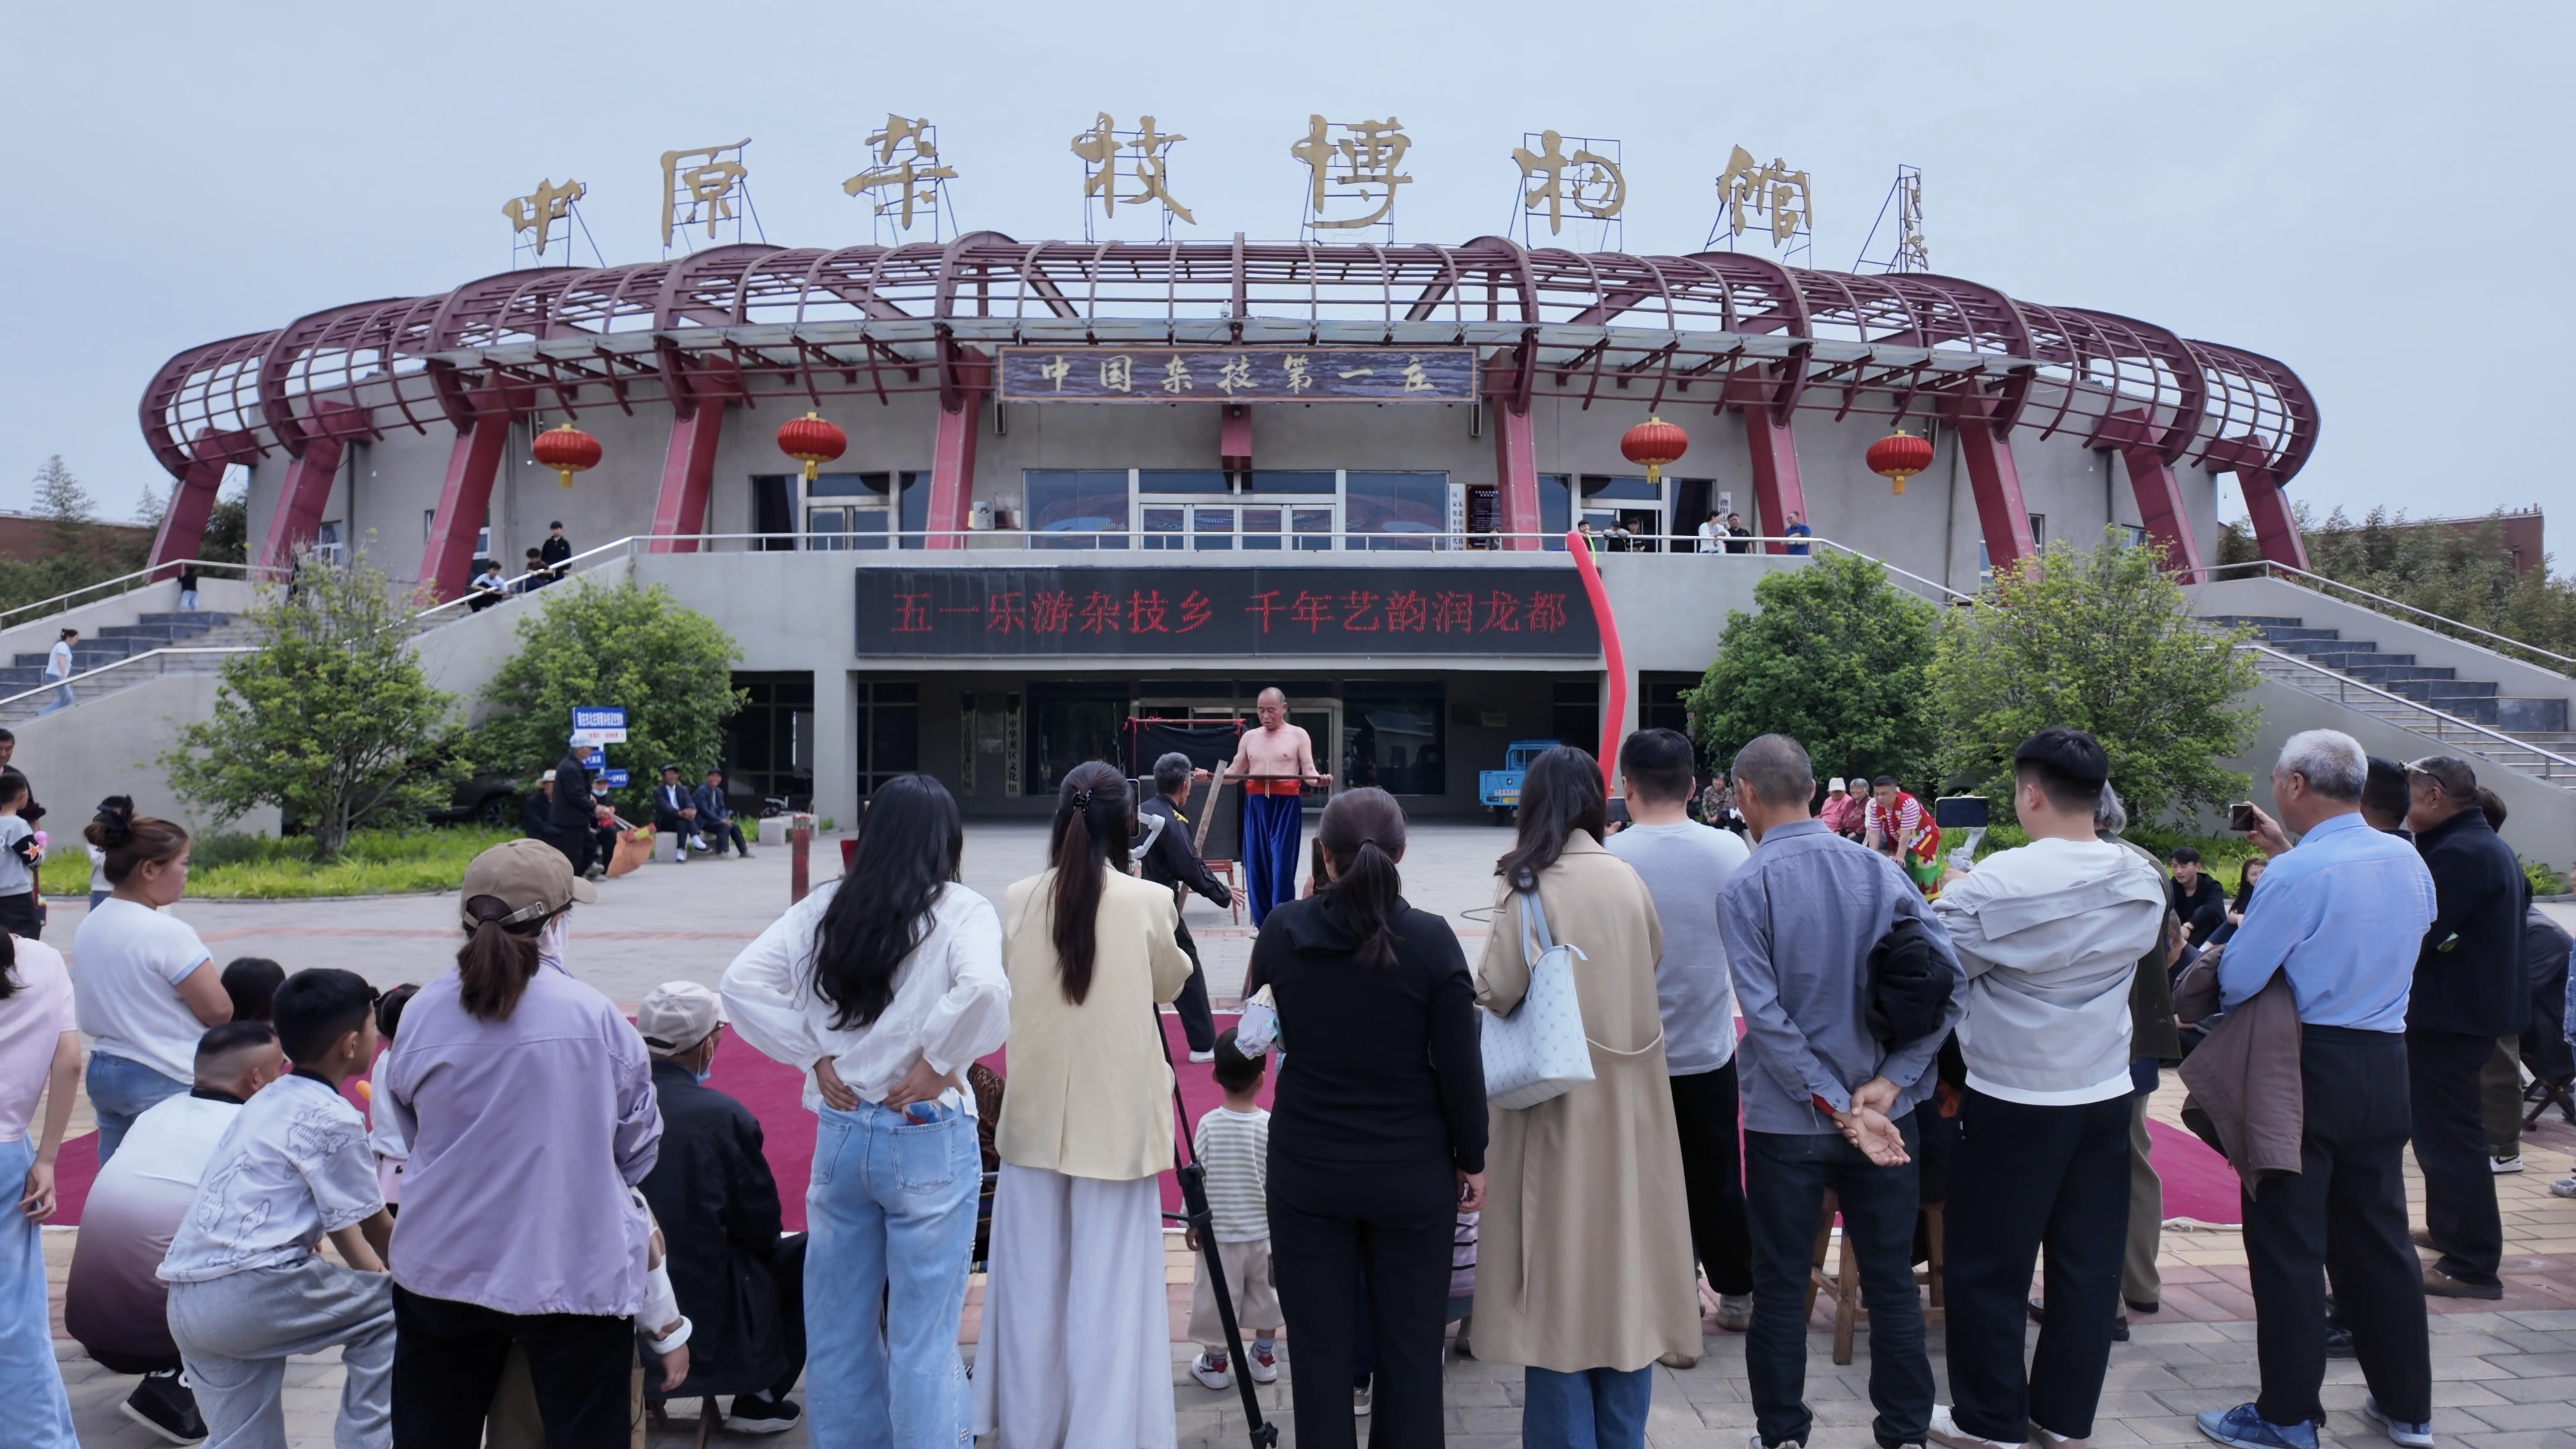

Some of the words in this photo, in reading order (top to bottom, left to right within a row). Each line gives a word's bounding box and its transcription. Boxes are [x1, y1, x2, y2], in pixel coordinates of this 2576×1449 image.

[1042, 353, 1435, 394] 中国杂技第一庄
[891, 590, 1212, 634] 五一乐游杂技乡
[1244, 590, 1566, 634] 千年艺韵润龙都
